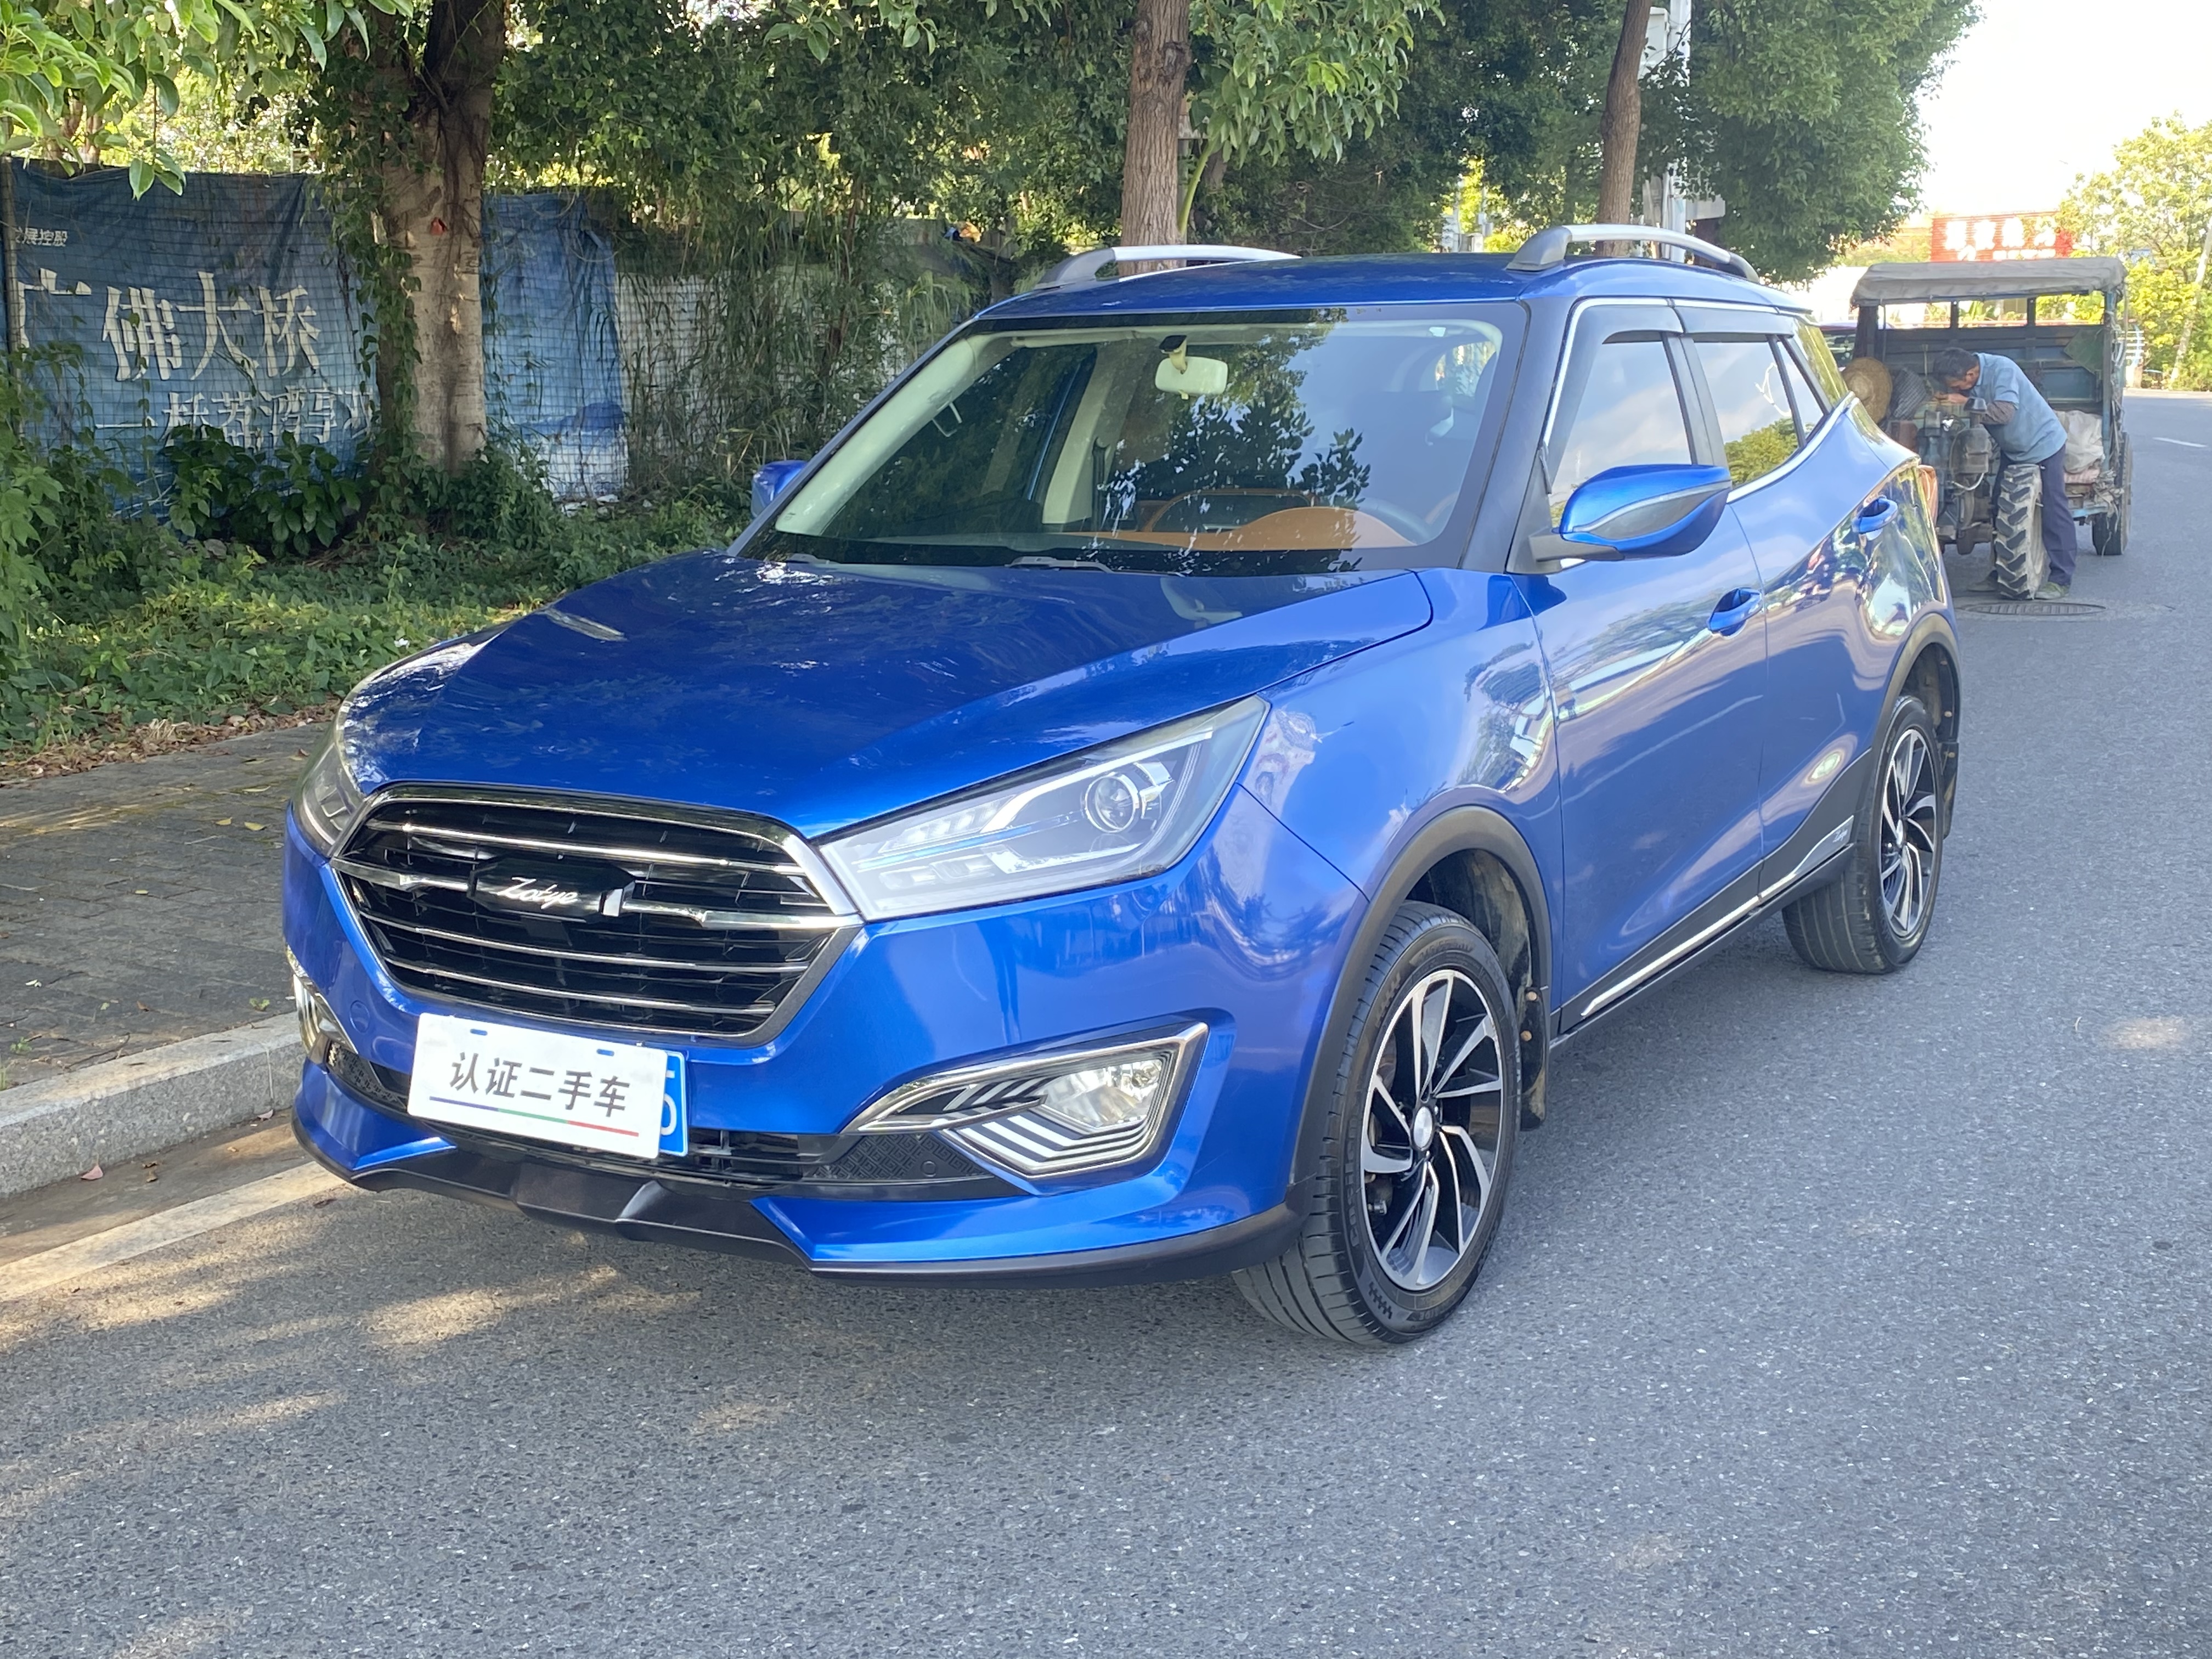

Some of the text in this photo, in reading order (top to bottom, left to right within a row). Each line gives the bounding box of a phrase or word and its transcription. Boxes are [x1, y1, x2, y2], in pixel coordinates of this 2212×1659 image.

[18, 268, 320, 381] 广佛大桥
[496, 876, 578, 910] Zotye
[449, 1051, 630, 1118] 认证二手车
